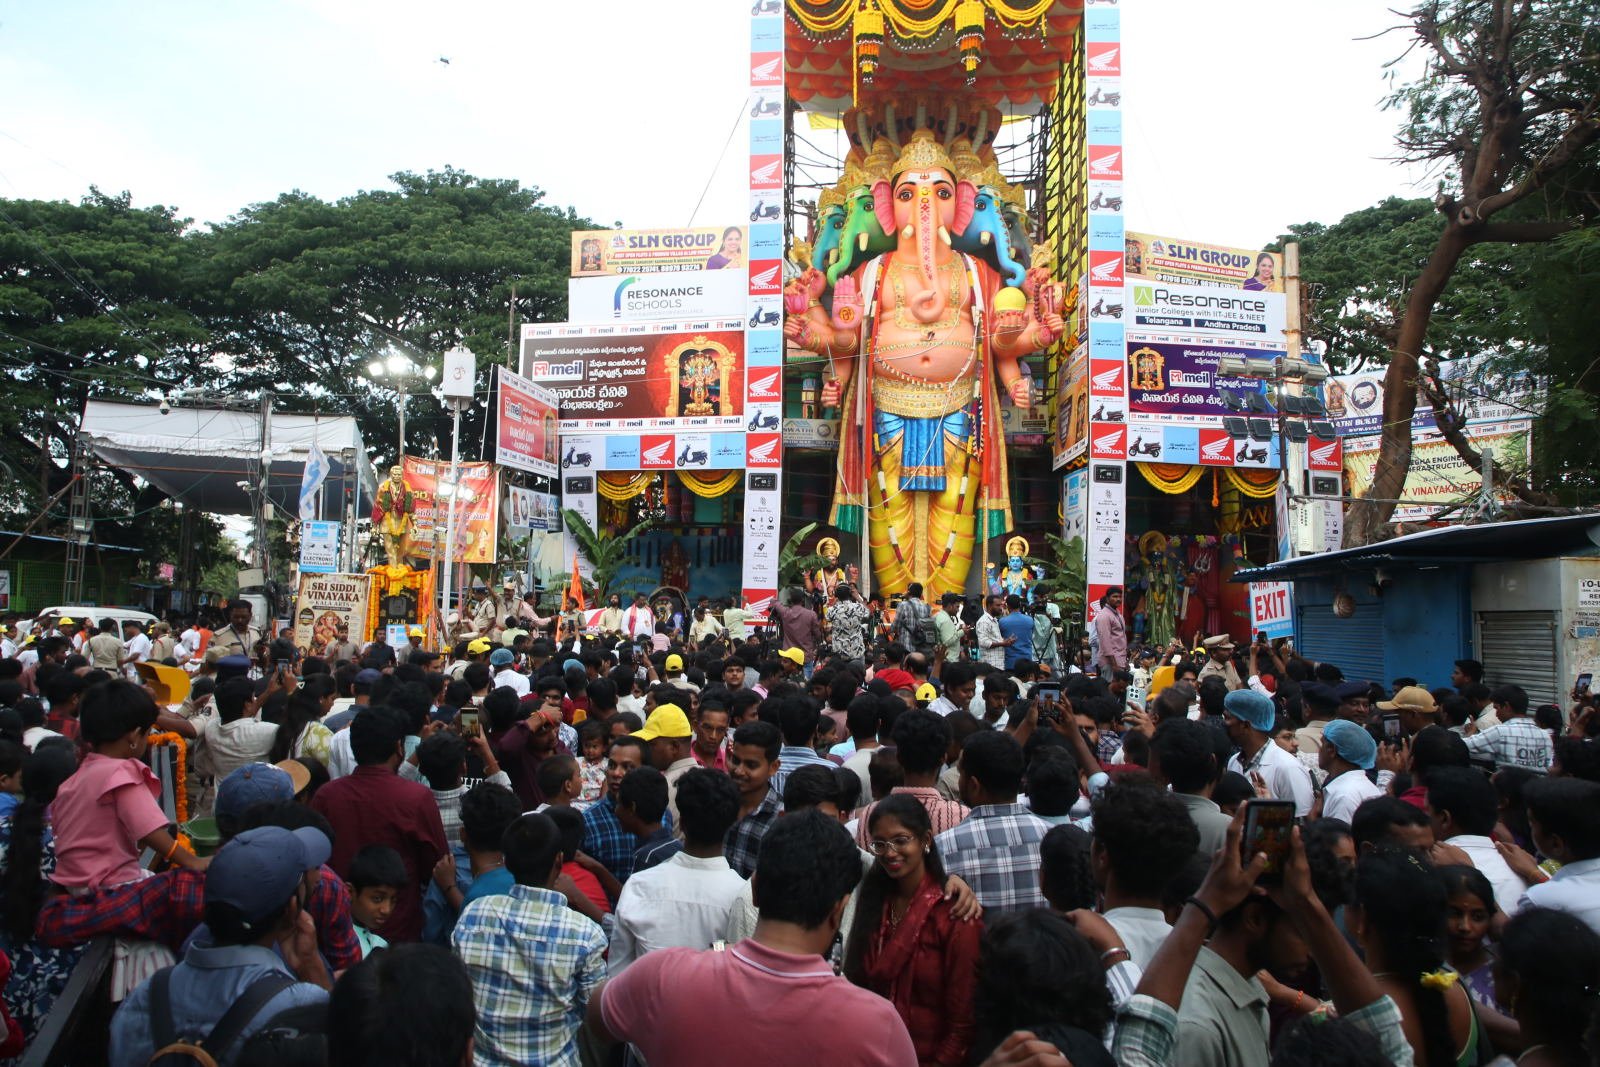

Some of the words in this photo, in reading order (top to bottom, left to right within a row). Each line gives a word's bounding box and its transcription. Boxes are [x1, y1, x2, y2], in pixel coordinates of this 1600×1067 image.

[629, 235, 659, 249] SLN
[663, 233, 716, 248] GROUP
[1168, 244, 1197, 261] SLN
[1200, 249, 1251, 268] GROUP
[627, 286, 704, 300] RESONANCE
[627, 298, 682, 311] SCHOOLS
[1154, 288, 1266, 313] Resonance
[1135, 305, 1160, 316] Junior
[1161, 307, 1194, 319] Colleges
[1196, 309, 1211, 318] with
[1213, 310, 1238, 320] IIT-JEE
[1239, 312, 1245, 320] &
[1246, 313, 1266, 322] NEET
[598, 327, 614, 335] meil
[661, 324, 677, 332] meil
[693, 323, 709, 331] meil
[725, 321, 741, 329] meil
[1144, 316, 1184, 326] Telangana
[1204, 320, 1231, 331] Andhra
[1232, 322, 1261, 333] Pradesh
[551, 361, 582, 375] meil
[1184, 371, 1209, 385] meil
[599, 385, 627, 399] చవితి
[1142, 392, 1180, 404] వినాయక
[594, 420, 611, 428] meil
[627, 419, 643, 427] meil
[659, 419, 675, 427] meil
[691, 418, 708, 426] meil
[723, 417, 741, 425] meil
[1093, 448, 1124, 456] HONDA
[1201, 454, 1231, 462] HONDA
[749, 457, 779, 465] HONDA
[1310, 460, 1339, 468] HONDA
[1411, 485, 1457, 497] VINAYAKA
[311, 582, 328, 591] SRI
[330, 583, 356, 593] SIDDI
[308, 590, 360, 603] VINAYAKA
[1255, 589, 1286, 622] EXIT
[1518, 747, 1547, 760] ONE
